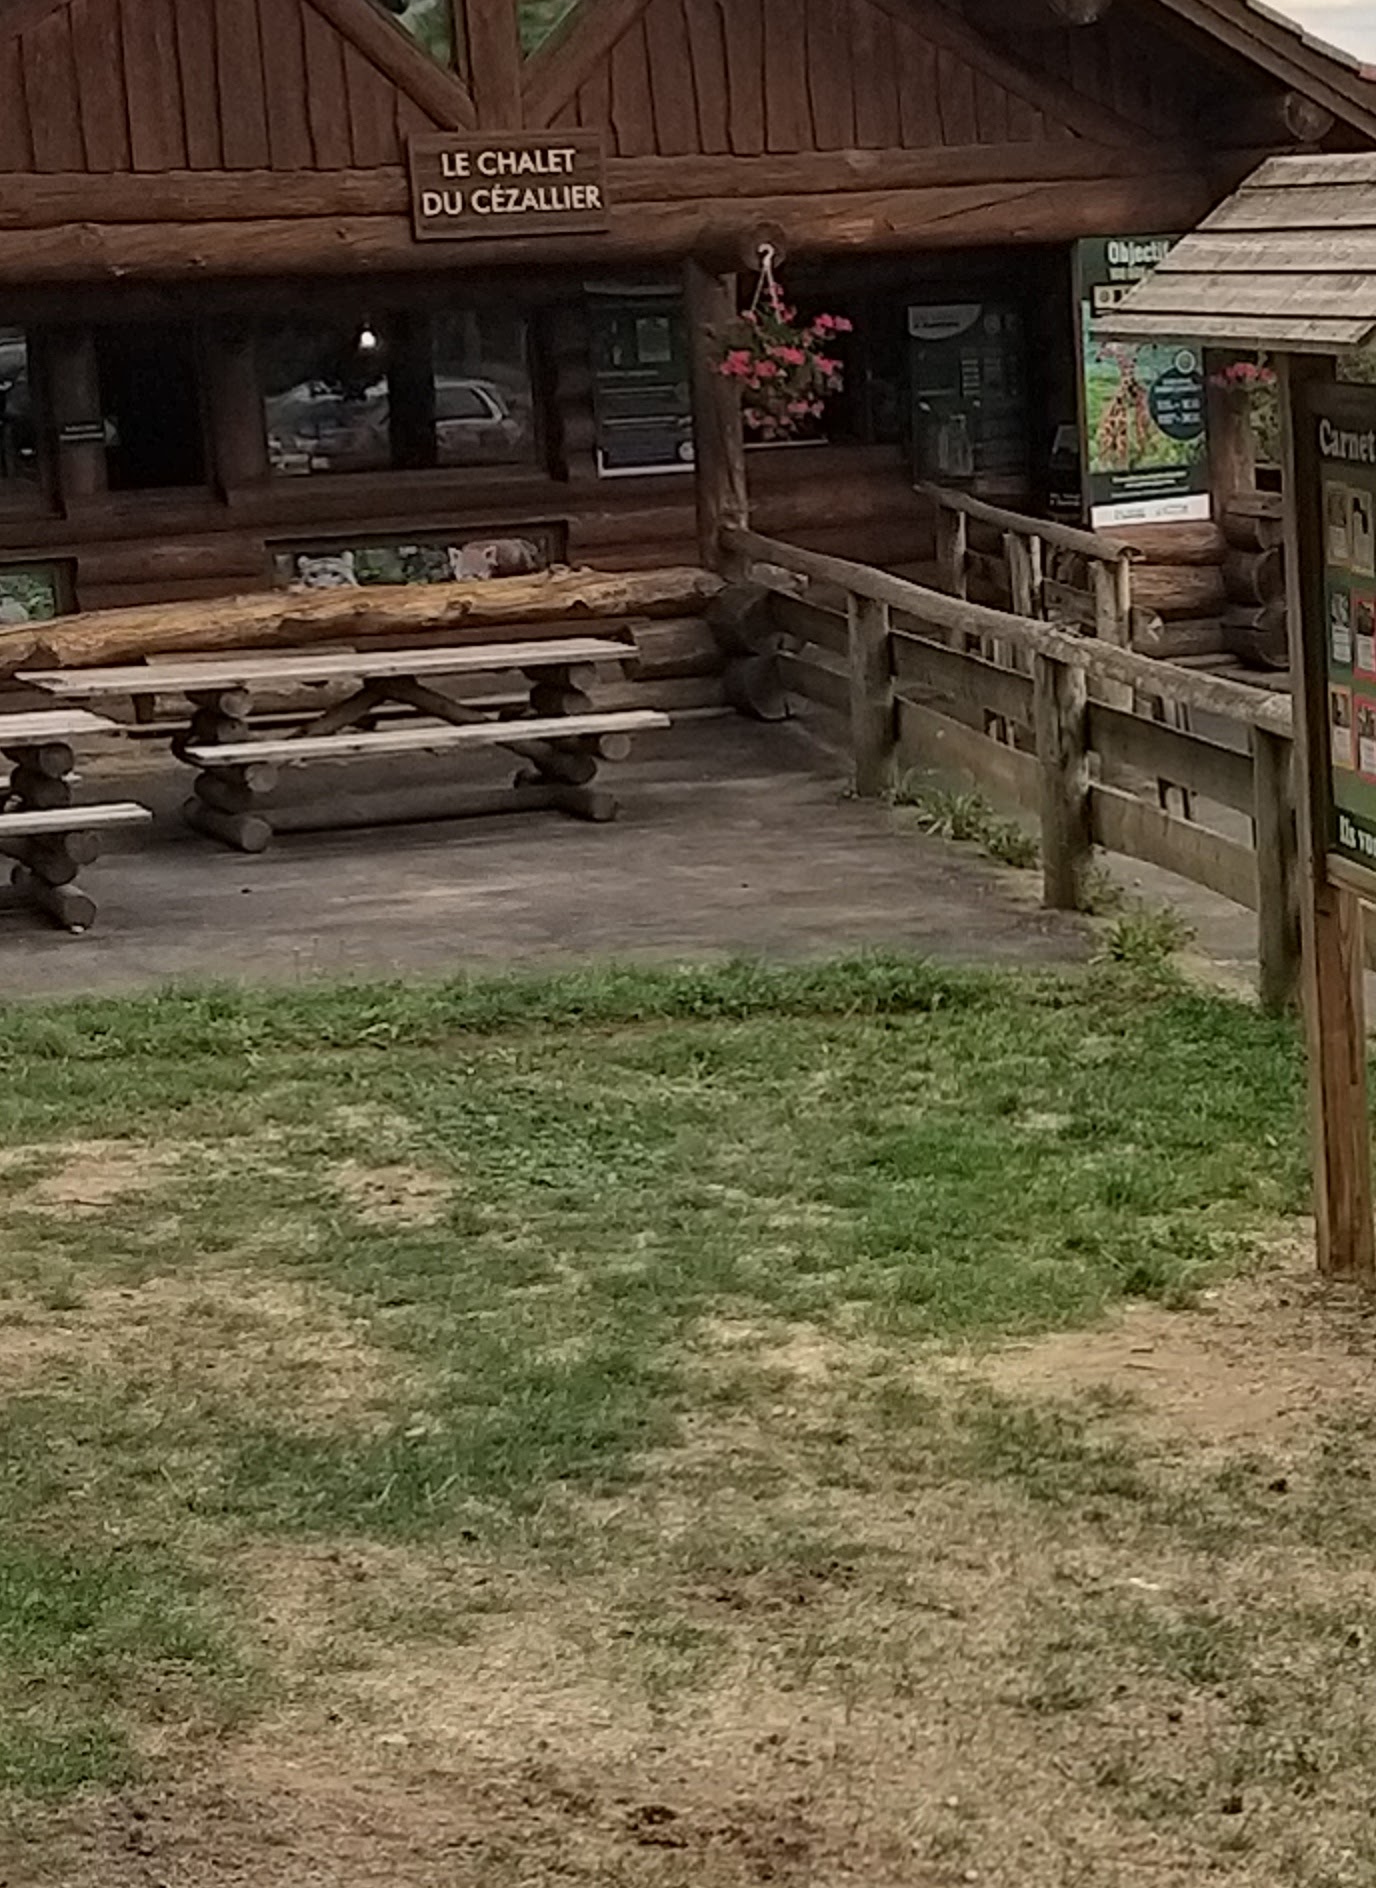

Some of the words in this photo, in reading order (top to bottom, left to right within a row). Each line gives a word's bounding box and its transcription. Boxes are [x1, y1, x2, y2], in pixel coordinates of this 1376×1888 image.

[441, 153, 471, 177] LE
[477, 149, 576, 176] CHALET
[422, 191, 462, 216] DU
[471, 184, 602, 213] CÉZALLIER
[1319, 418, 1376, 463] Carnet
